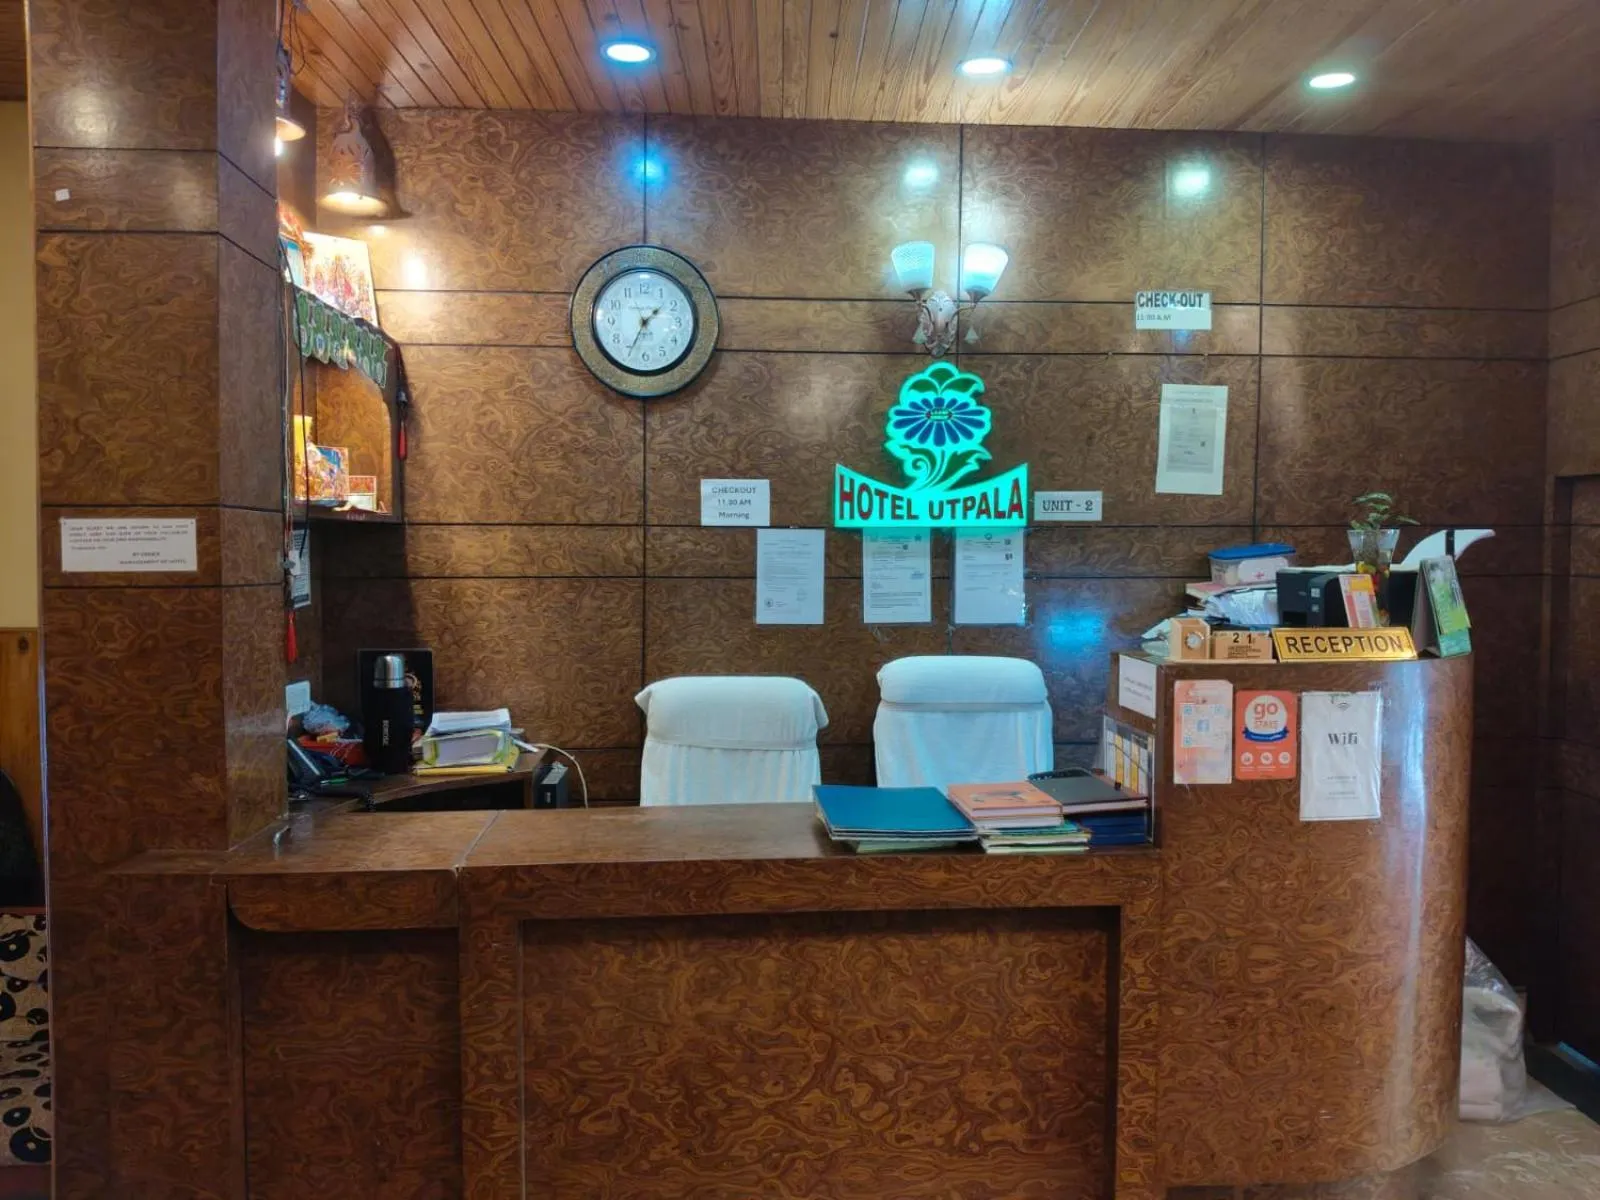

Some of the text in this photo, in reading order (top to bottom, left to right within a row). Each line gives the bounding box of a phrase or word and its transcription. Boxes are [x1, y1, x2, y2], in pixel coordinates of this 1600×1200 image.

[624, 287, 632, 298] 11
[639, 283, 650, 294] 12
[658, 288, 664, 298] 1
[611, 299, 621, 310] 10
[1138, 292, 1203, 308] CHECK-OUT
[670, 300, 678, 312] 2
[607, 317, 615, 326] 9
[674, 317, 682, 328] 3
[612, 333, 621, 344] 8
[670, 336, 678, 345] 4
[642, 351, 650, 362] 6
[658, 346, 666, 357] 5
[711, 486, 757, 494] CHECKOUT
[839, 474, 1024, 520] HOTEL UTPALA
[1042, 499, 1073, 512] UNIT
[1085, 499, 1093, 511] 2
[718, 511, 750, 520] Morning
[1286, 635, 1405, 654] RECEPTION
[1253, 702, 1278, 720] go
[1328, 732, 1358, 745] Wifi
